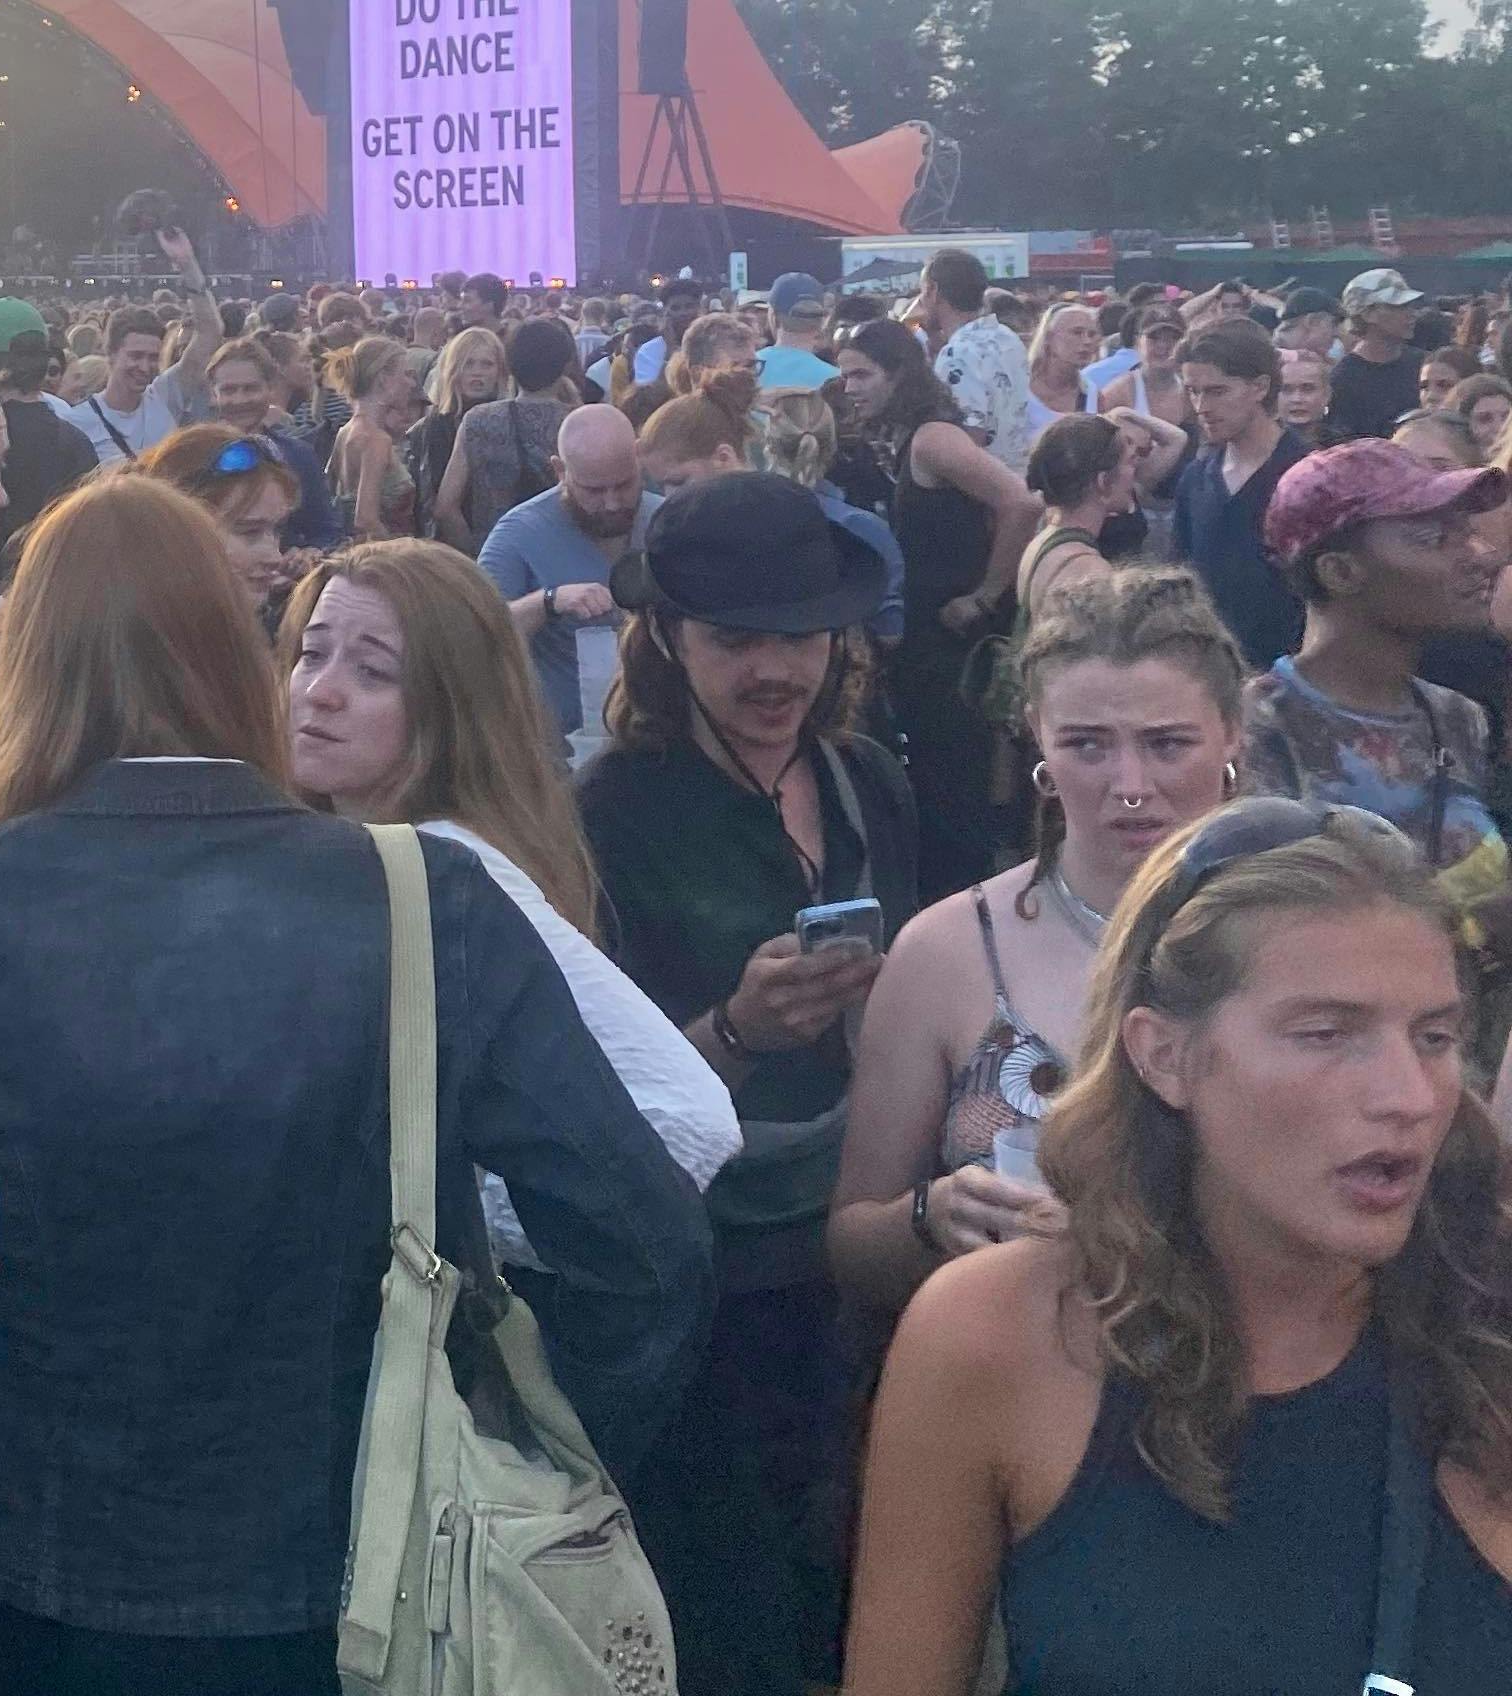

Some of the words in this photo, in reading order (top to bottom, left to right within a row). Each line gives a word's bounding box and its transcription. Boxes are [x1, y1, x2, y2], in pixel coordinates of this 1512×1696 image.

[395, 0, 440, 26] DO
[400, 30, 515, 80] DANCE
[361, 115, 423, 158] GET
[433, 112, 480, 154] ON
[490, 106, 561, 151] THE
[393, 164, 525, 210] SCREEN
